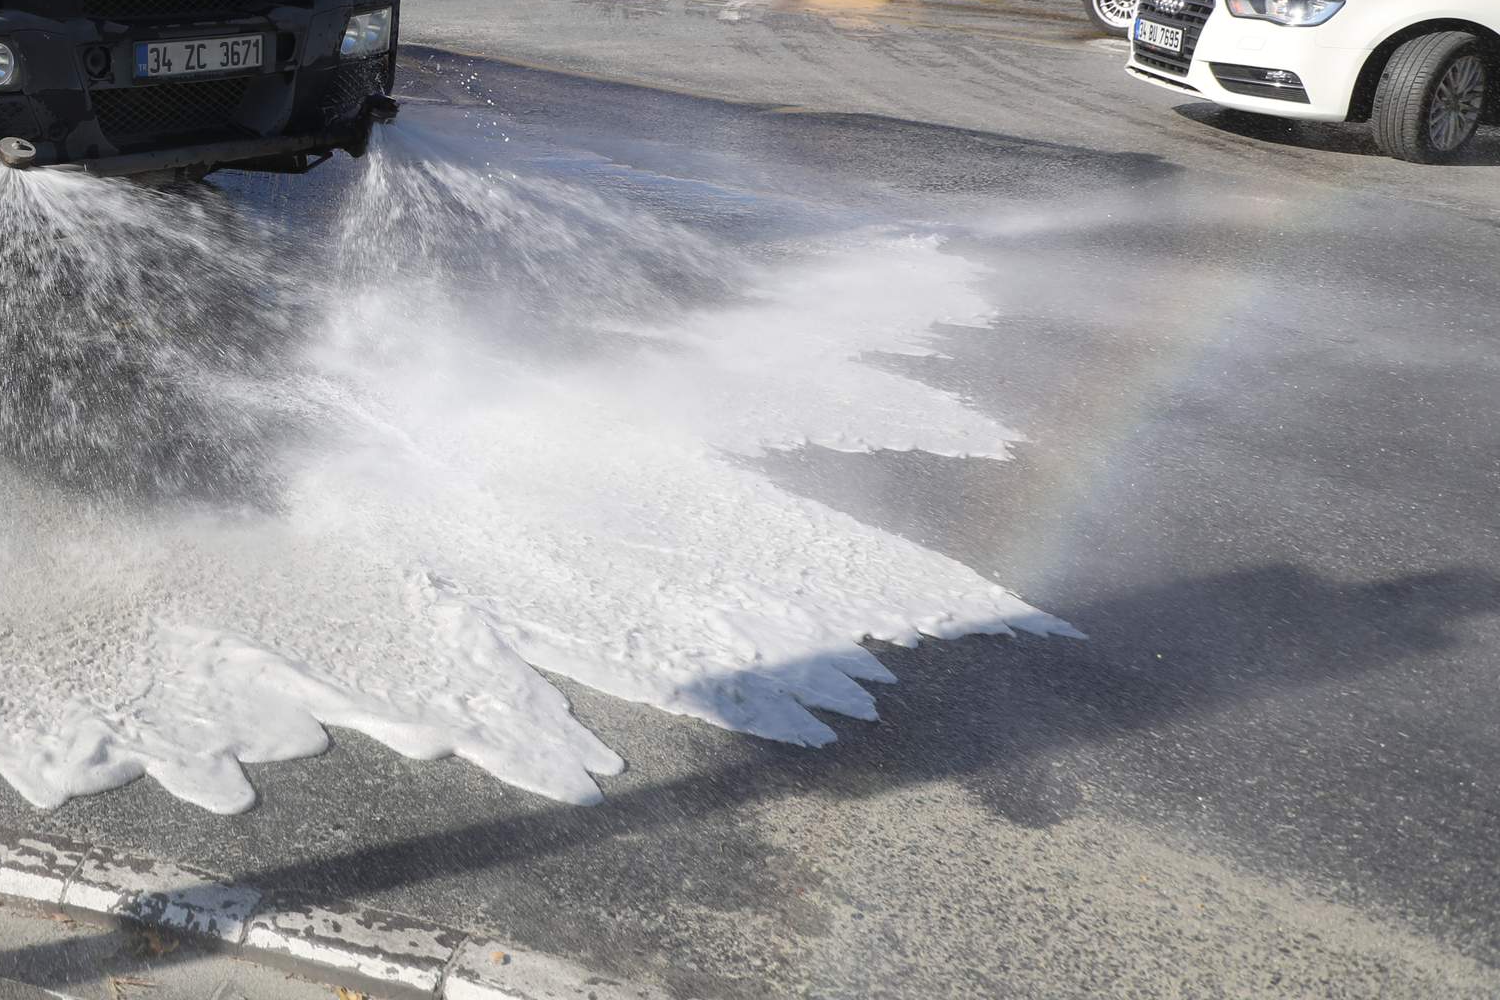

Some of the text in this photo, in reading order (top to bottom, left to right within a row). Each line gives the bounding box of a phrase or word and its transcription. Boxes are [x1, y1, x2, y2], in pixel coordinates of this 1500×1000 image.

[1140, 21, 1147, 40] 34
[1160, 27, 1180, 48] 7695
[149, 39, 260, 73] 34 ZC 3671
